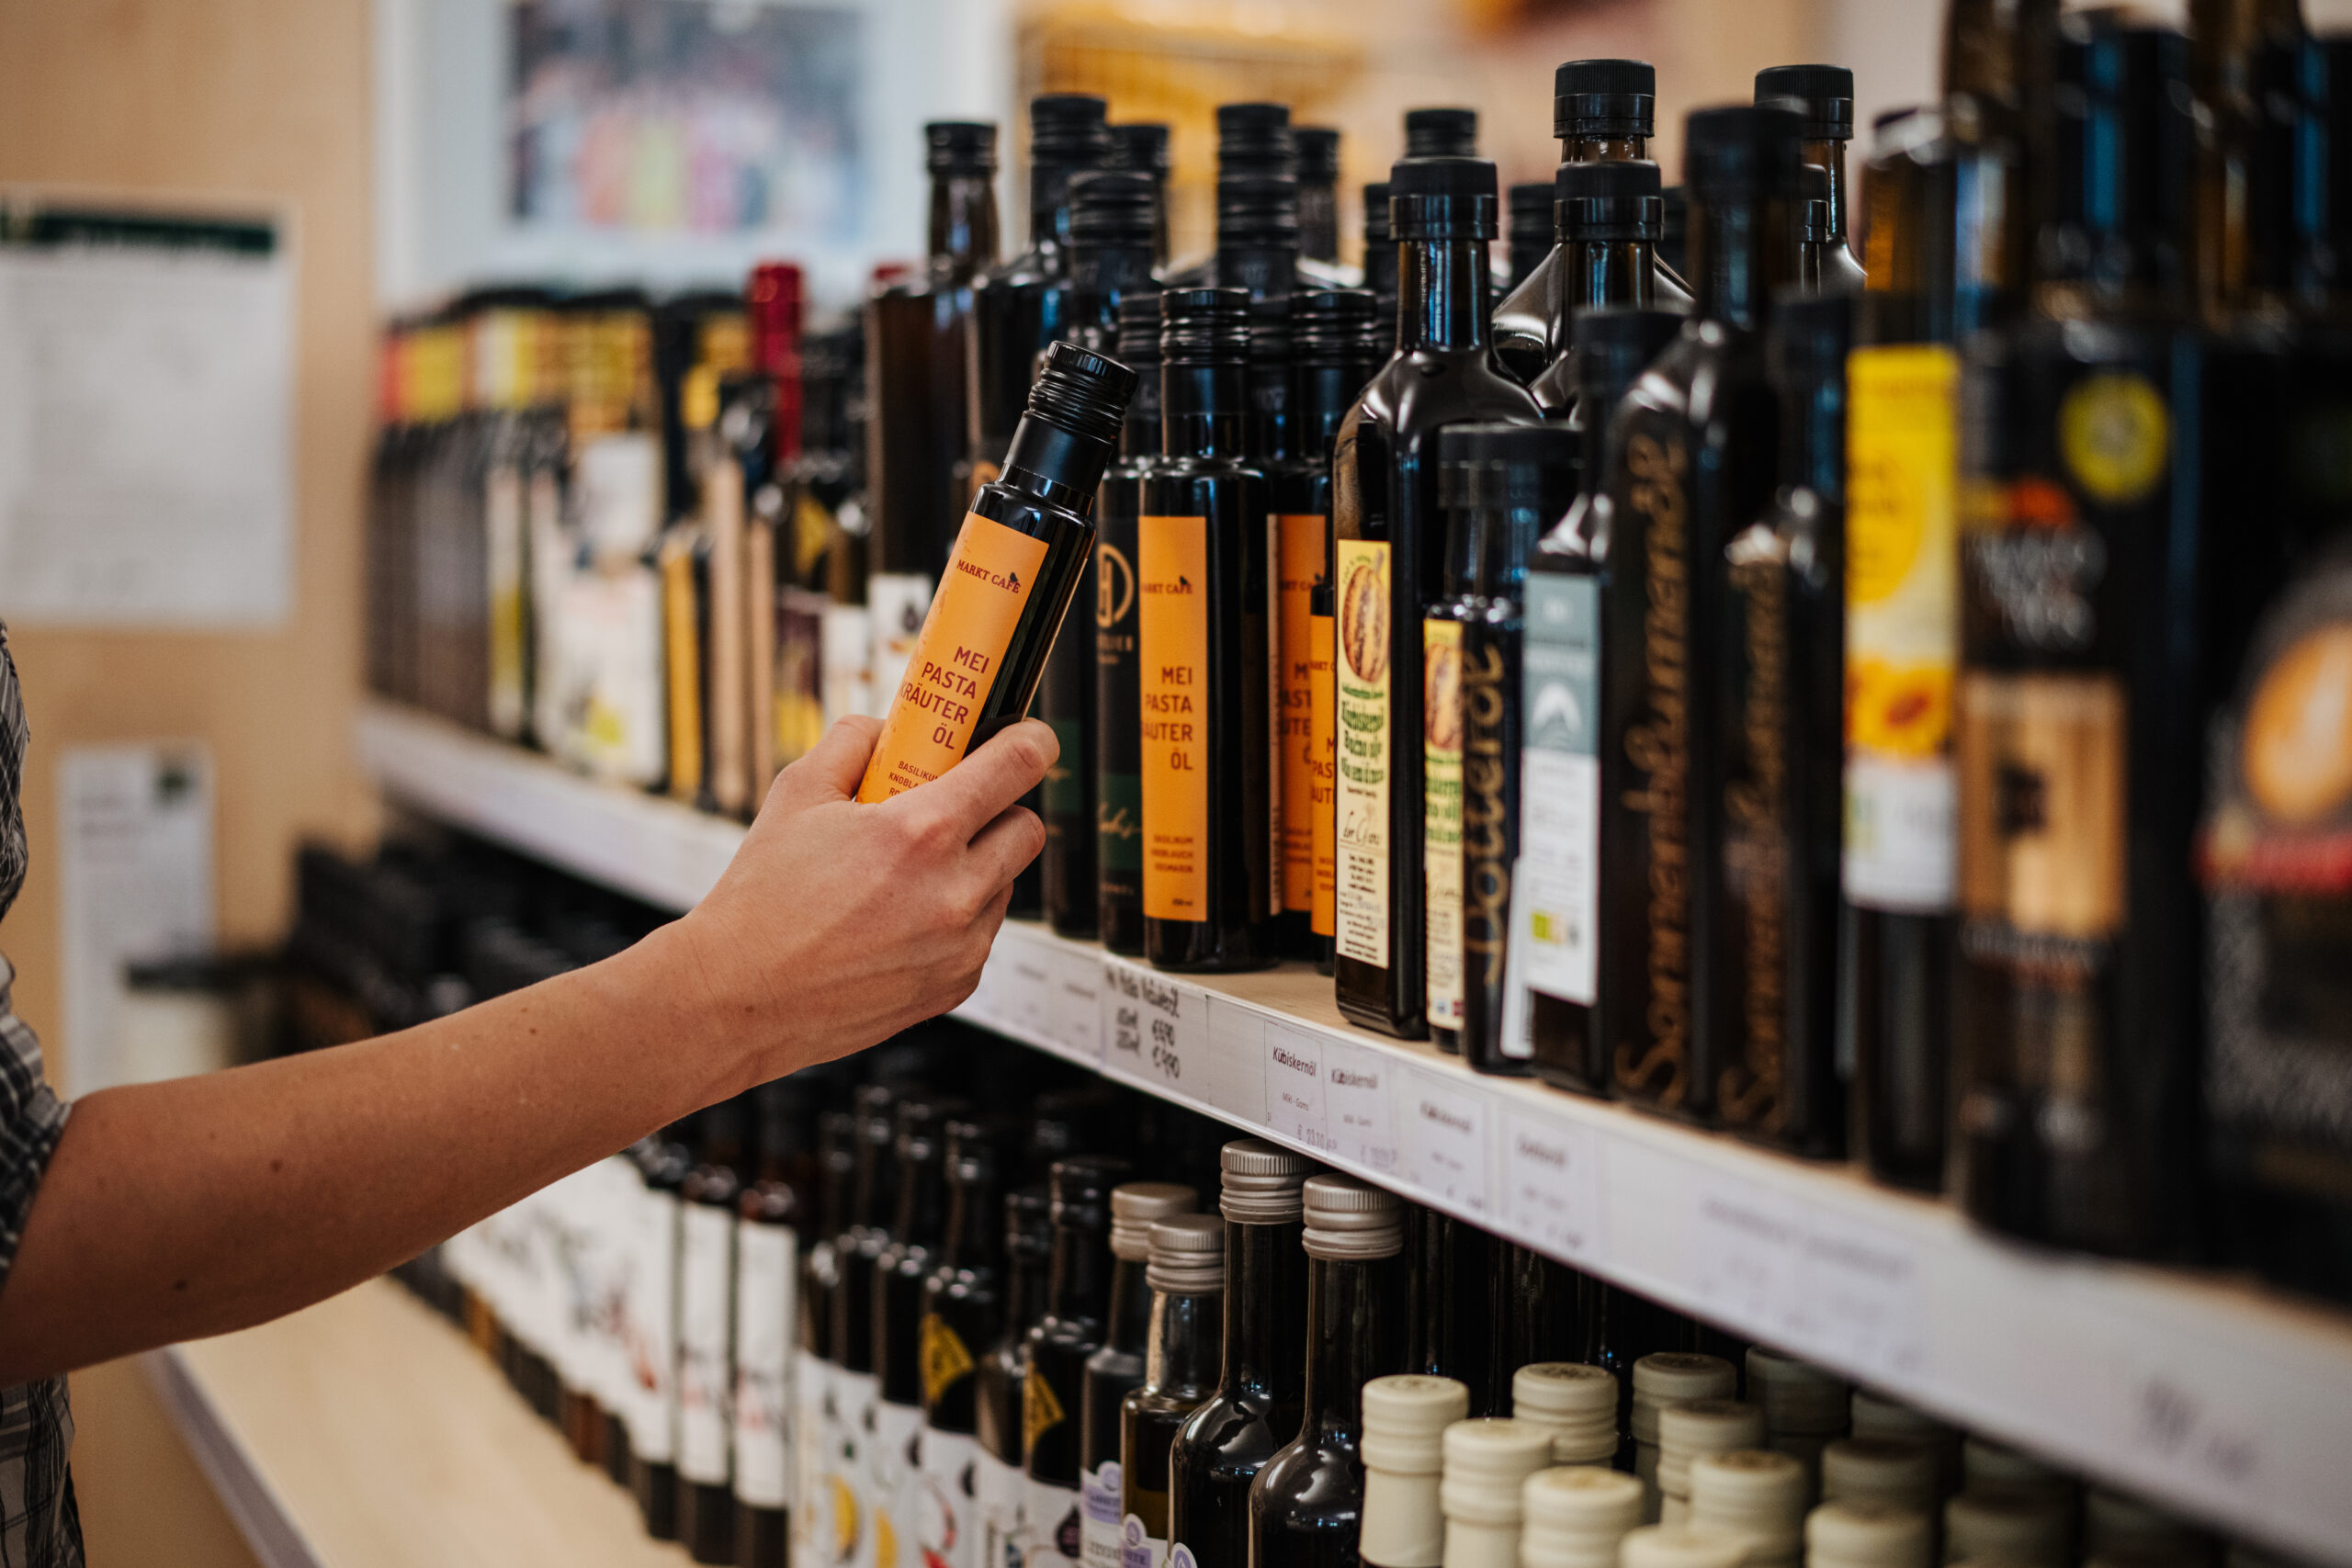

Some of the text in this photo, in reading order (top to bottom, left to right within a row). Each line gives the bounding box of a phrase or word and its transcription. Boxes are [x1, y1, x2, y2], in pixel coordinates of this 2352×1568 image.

[956, 558, 990, 581] MARKT
[954, 646, 989, 674] MEI
[922, 661, 977, 700] PASTA
[1161, 666, 1193, 685] MEI
[933, 722, 955, 750] ÖL
[1170, 747, 1193, 771] ÖL
[888, 772, 919, 789] KNOBLA
